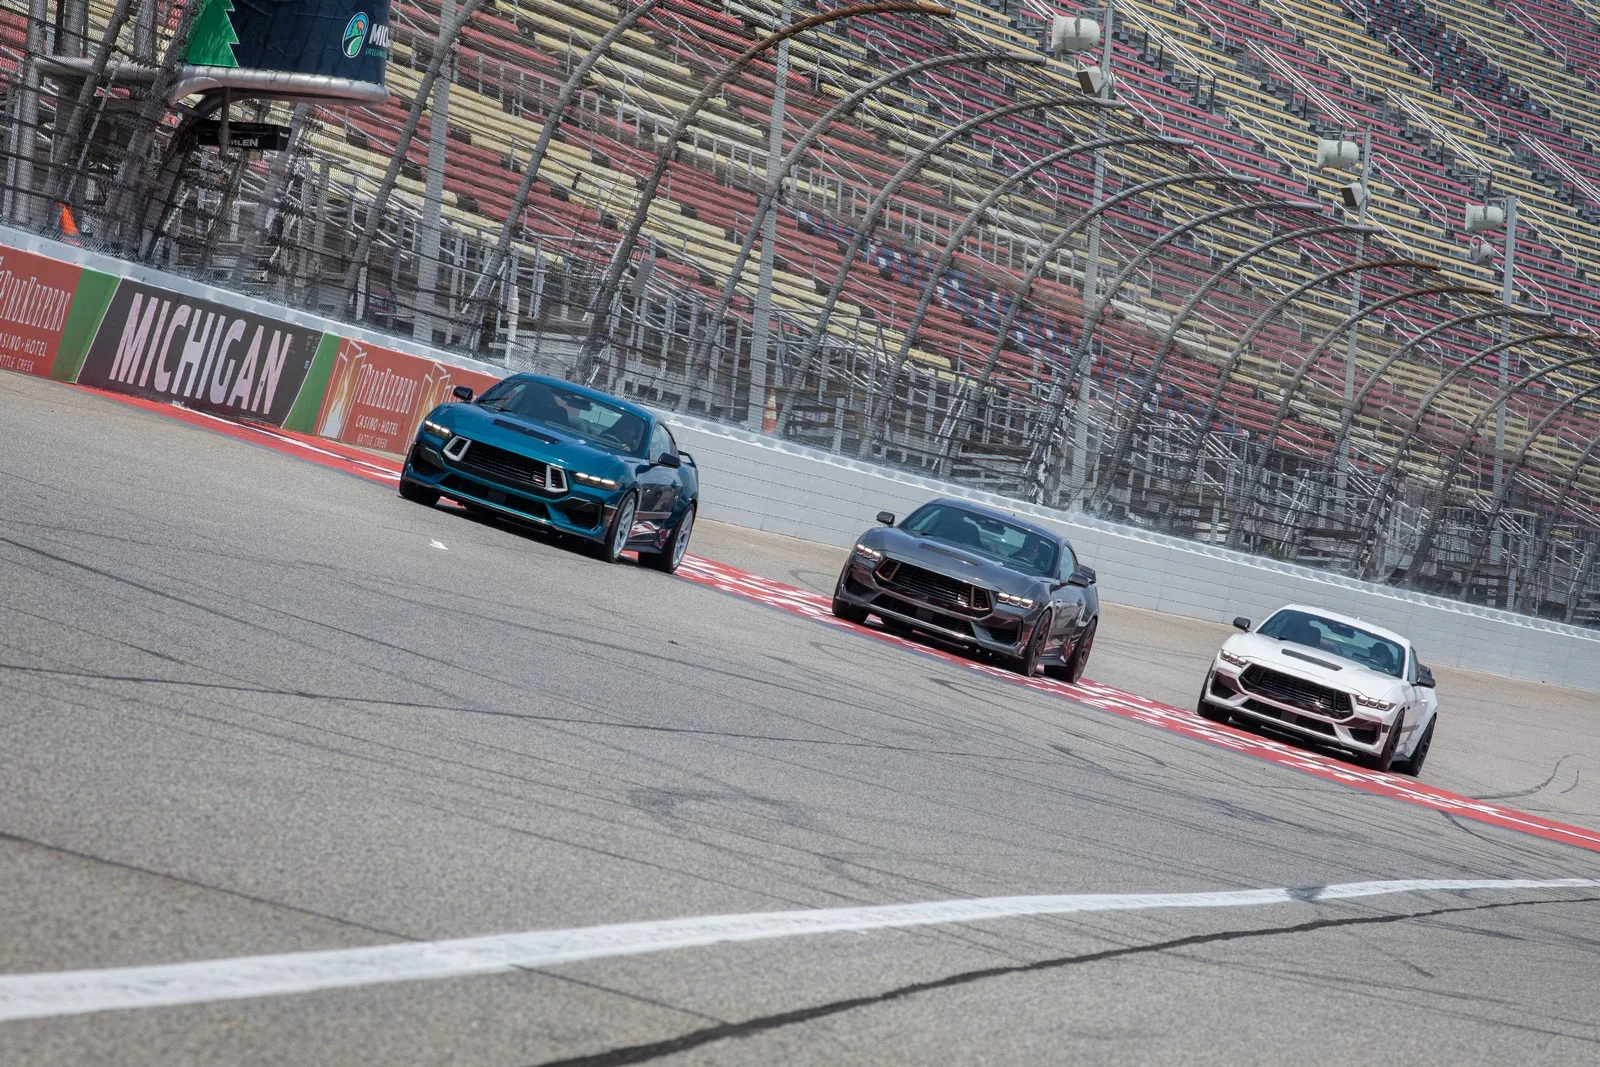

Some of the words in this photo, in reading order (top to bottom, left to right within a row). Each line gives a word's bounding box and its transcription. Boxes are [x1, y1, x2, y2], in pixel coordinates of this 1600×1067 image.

[24, 338, 48, 357] HOTEL
[109, 293, 293, 415] MICHIGAN
[17, 358, 35, 372] CREEK
[356, 414, 379, 431] CASINO
[380, 420, 399, 436] HOTEL
[357, 433, 374, 446] BATTLE
[374, 437, 389, 449] CREEK
